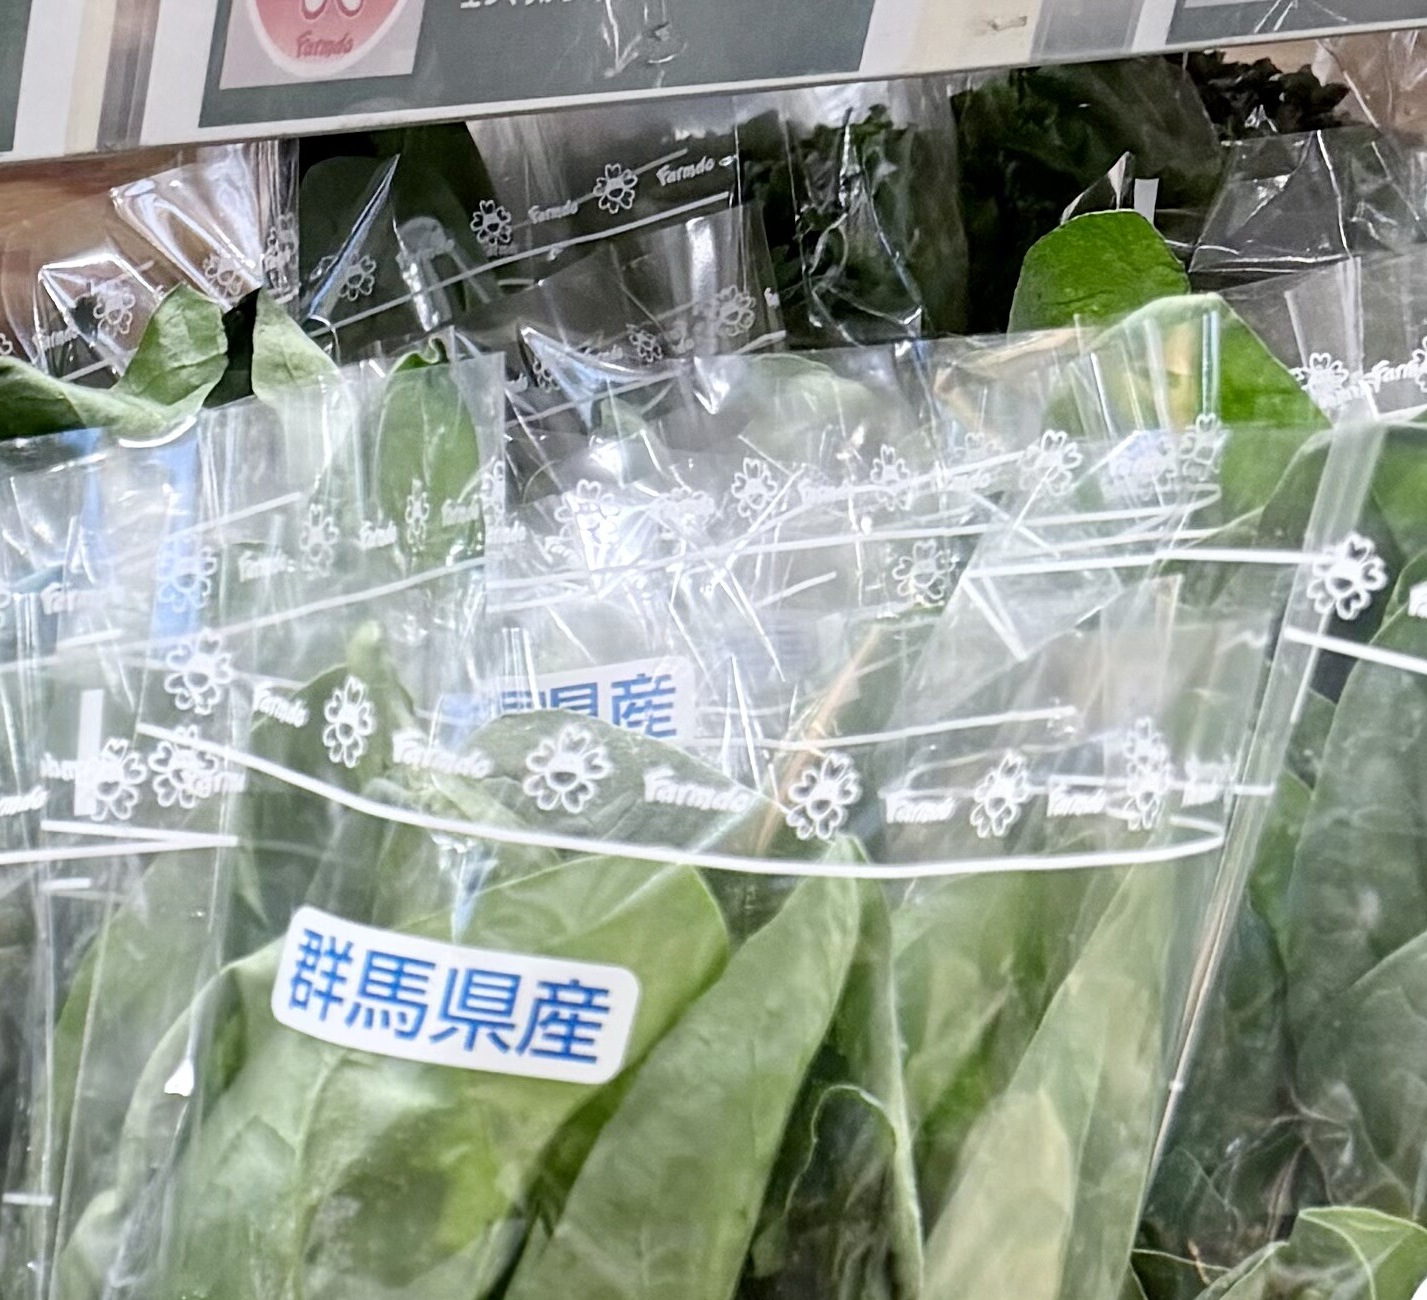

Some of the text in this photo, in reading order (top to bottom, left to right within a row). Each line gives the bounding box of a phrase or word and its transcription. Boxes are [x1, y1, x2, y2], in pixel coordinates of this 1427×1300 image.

[294, 31, 355, 59] Farmdo
[657, 155, 715, 187] Farmdo
[252, 680, 310, 729] Farmdo
[287, 927, 612, 1067] 群馬県産
